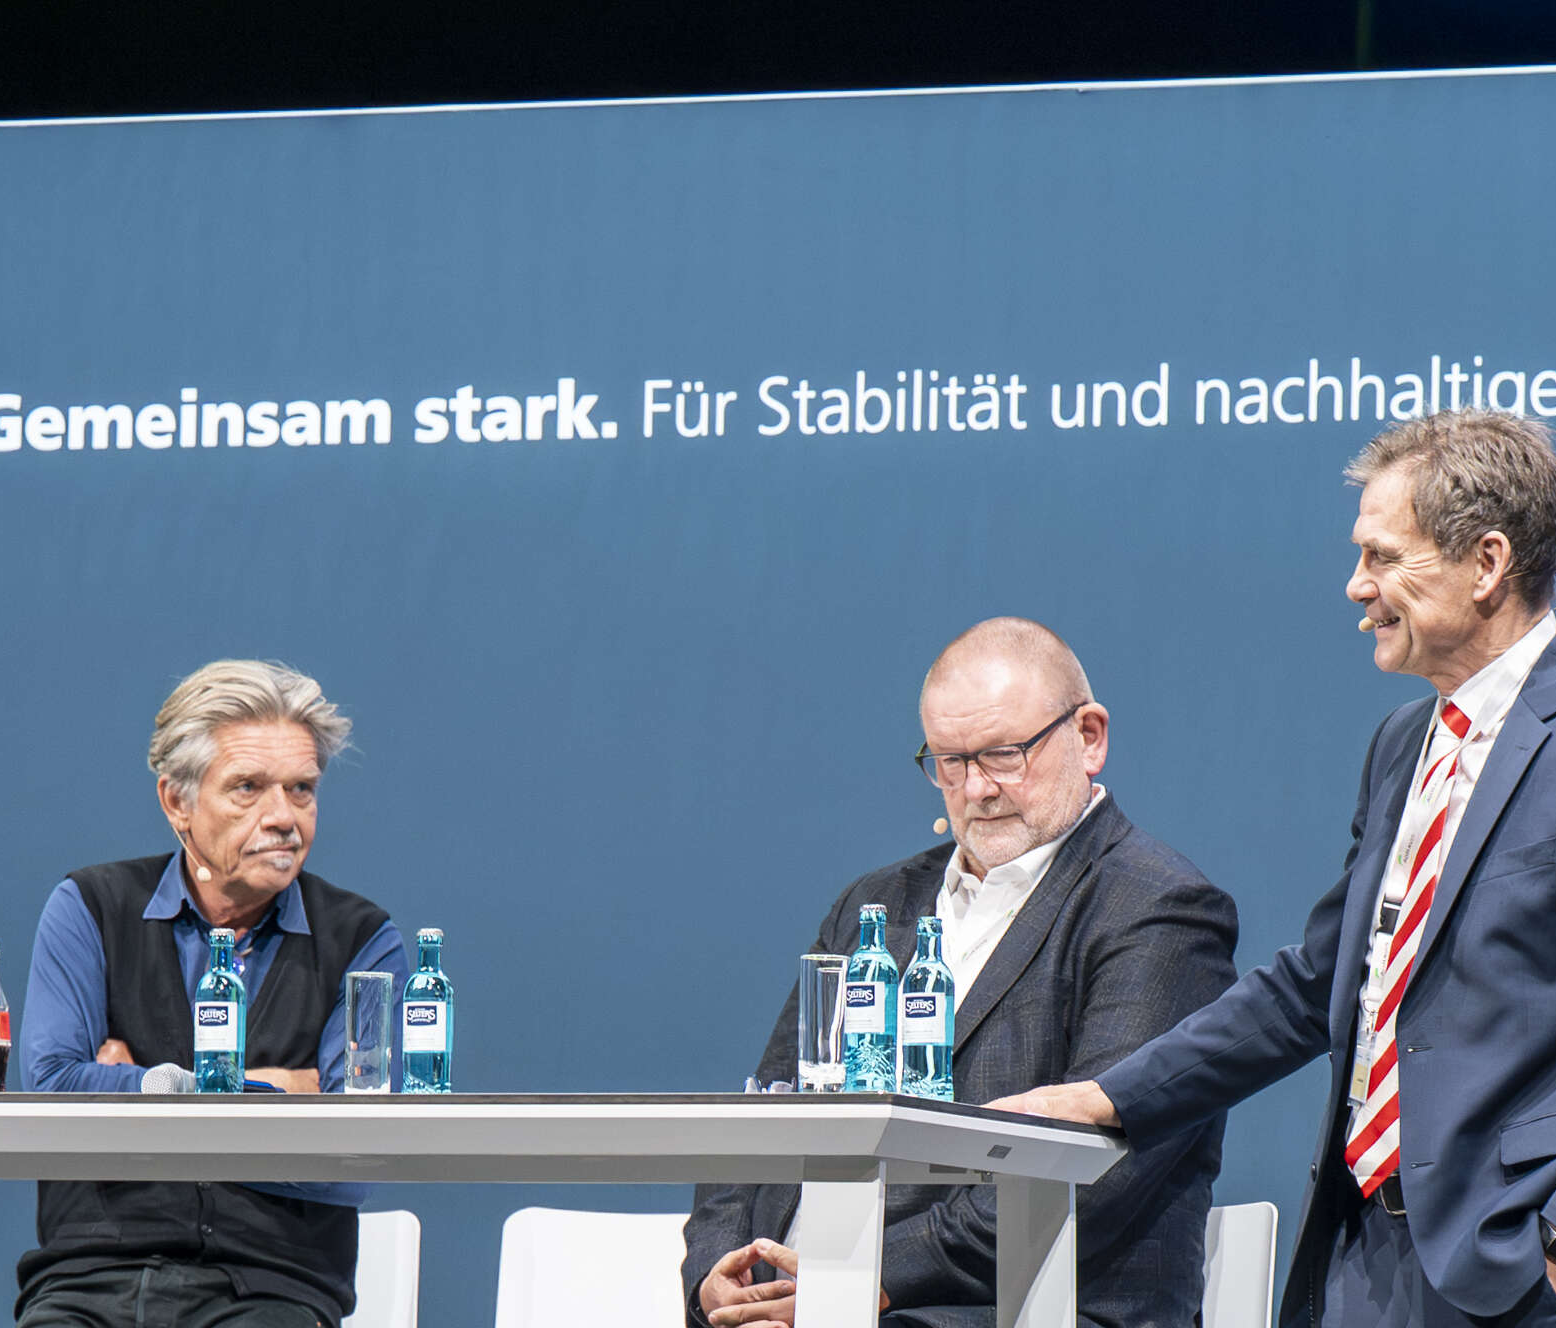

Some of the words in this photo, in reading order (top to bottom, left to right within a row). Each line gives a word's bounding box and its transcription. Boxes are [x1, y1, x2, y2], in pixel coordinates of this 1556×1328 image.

[414, 377, 619, 445] stark.
[641, 378, 738, 440] Für
[757, 369, 1029, 437] Stabilität
[1050, 361, 1170, 430] und
